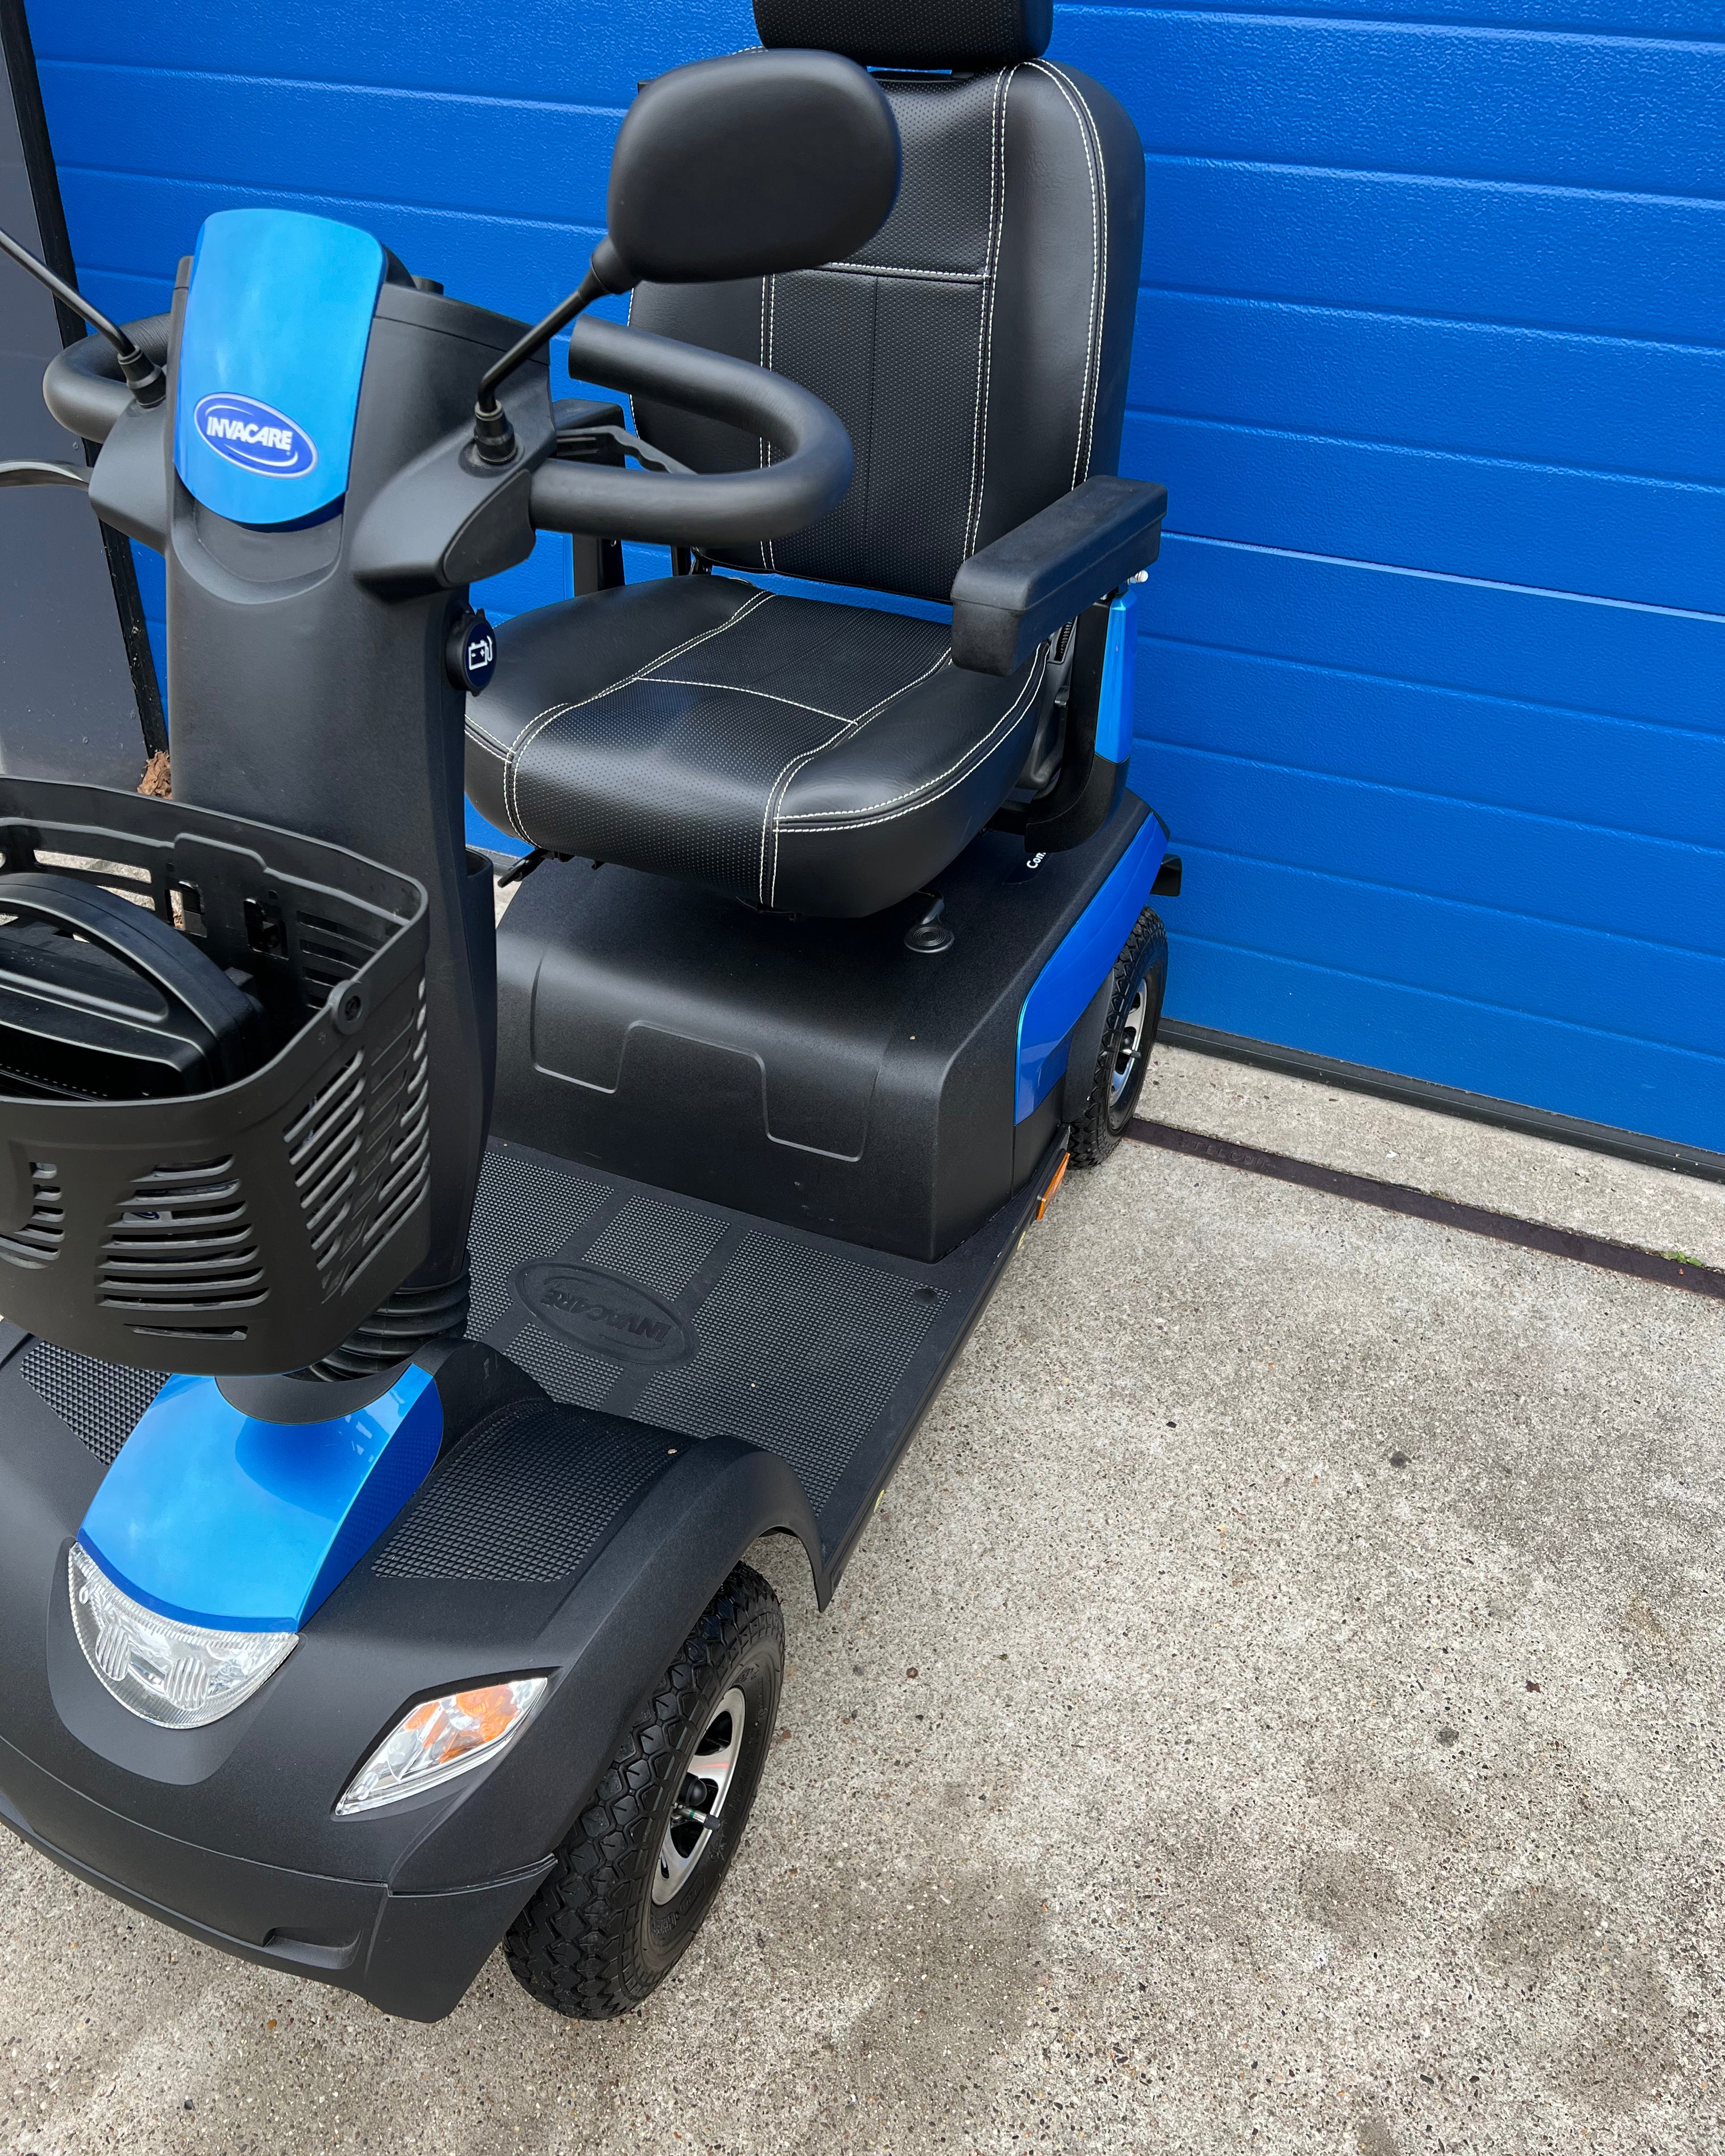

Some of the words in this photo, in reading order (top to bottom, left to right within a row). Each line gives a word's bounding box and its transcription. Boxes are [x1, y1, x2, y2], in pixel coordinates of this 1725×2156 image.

[206, 416, 293, 451] INVACARE
[1027, 852, 1047, 869] Com
[540, 1288, 672, 1340] INVACARE
